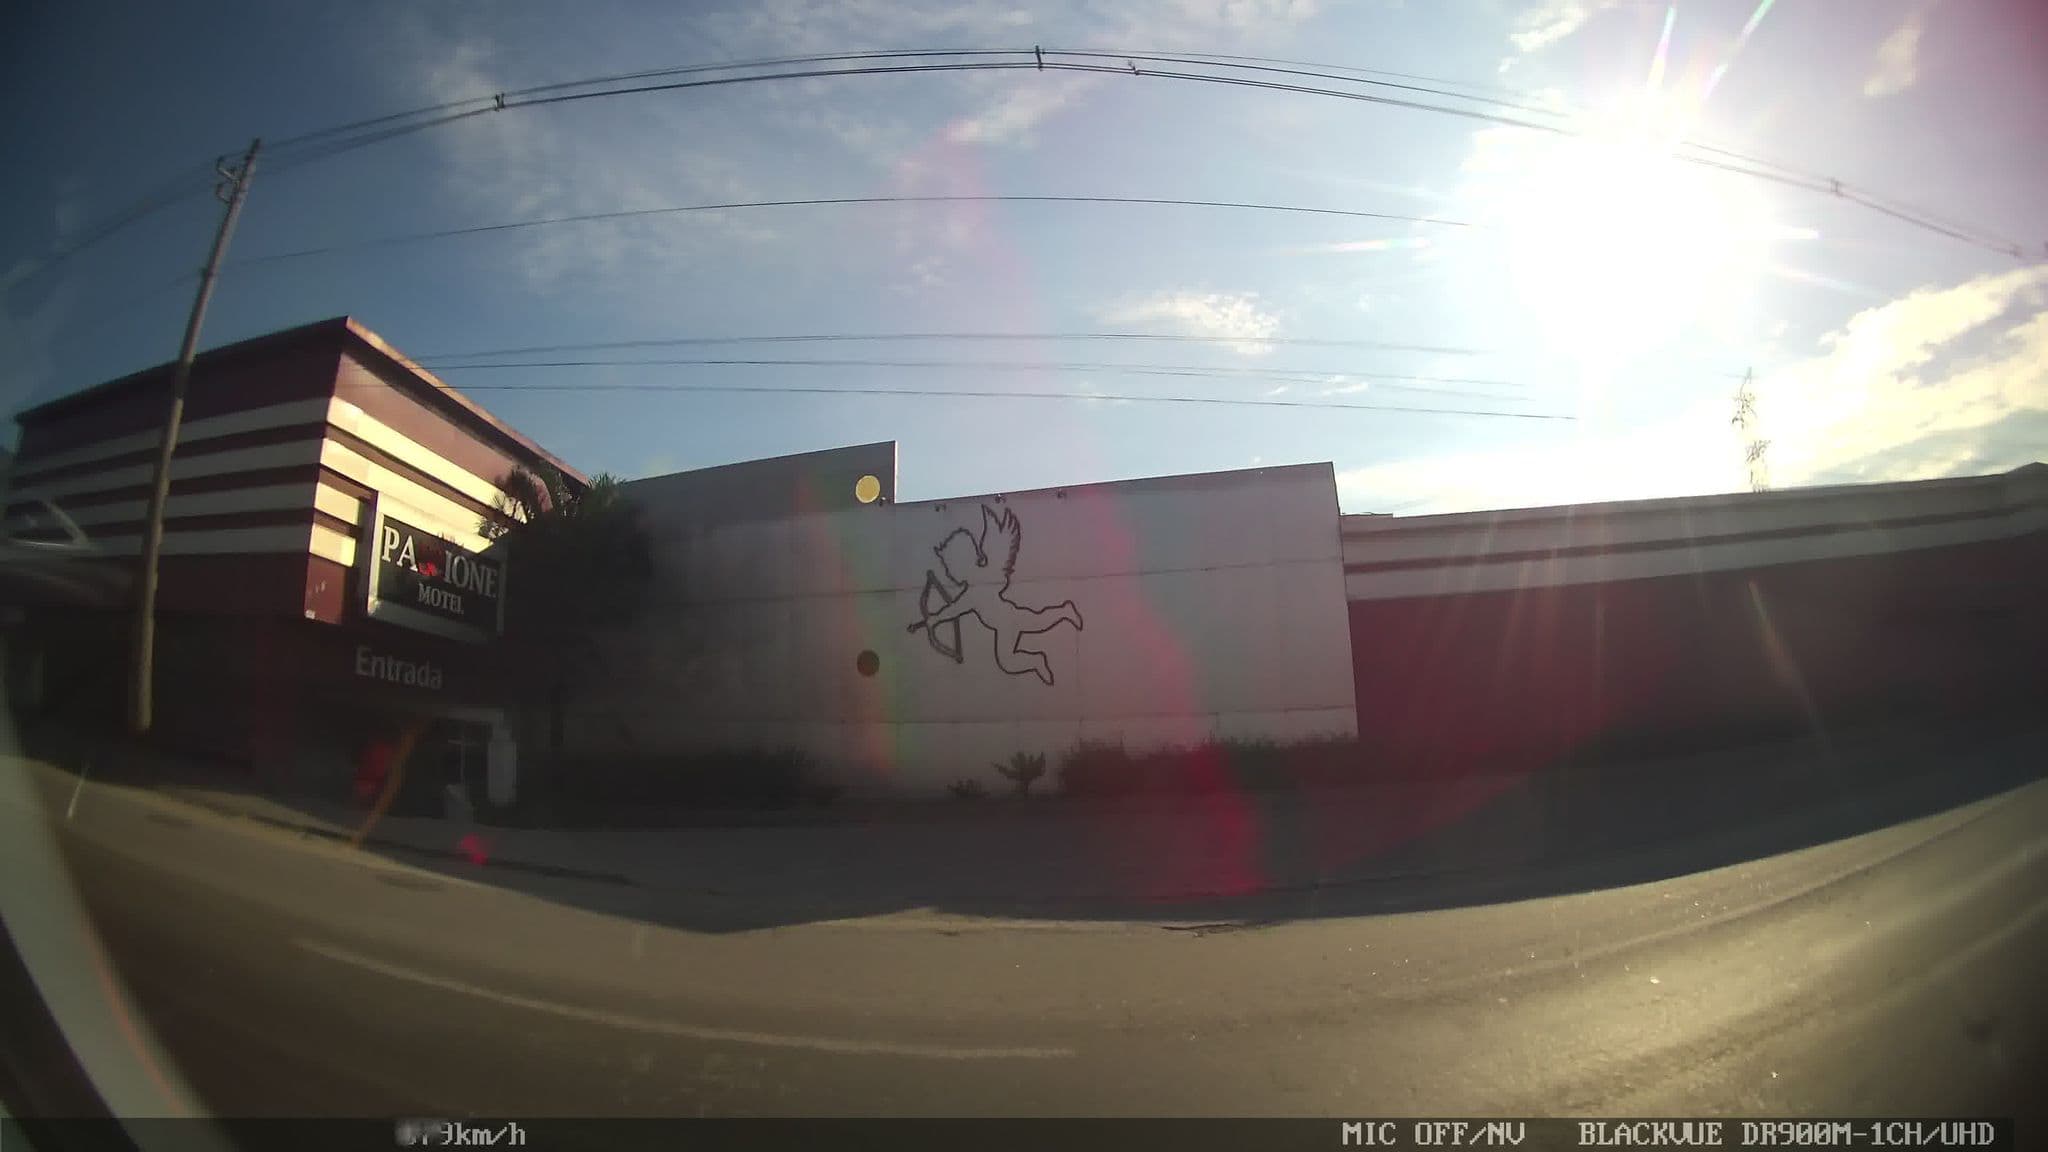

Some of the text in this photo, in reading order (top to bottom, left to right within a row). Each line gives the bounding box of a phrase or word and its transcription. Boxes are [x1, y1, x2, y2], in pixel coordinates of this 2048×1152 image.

[381, 525, 498, 598] PAIONE
[418, 583, 464, 615] MOTEL
[355, 645, 443, 689] Entrada
